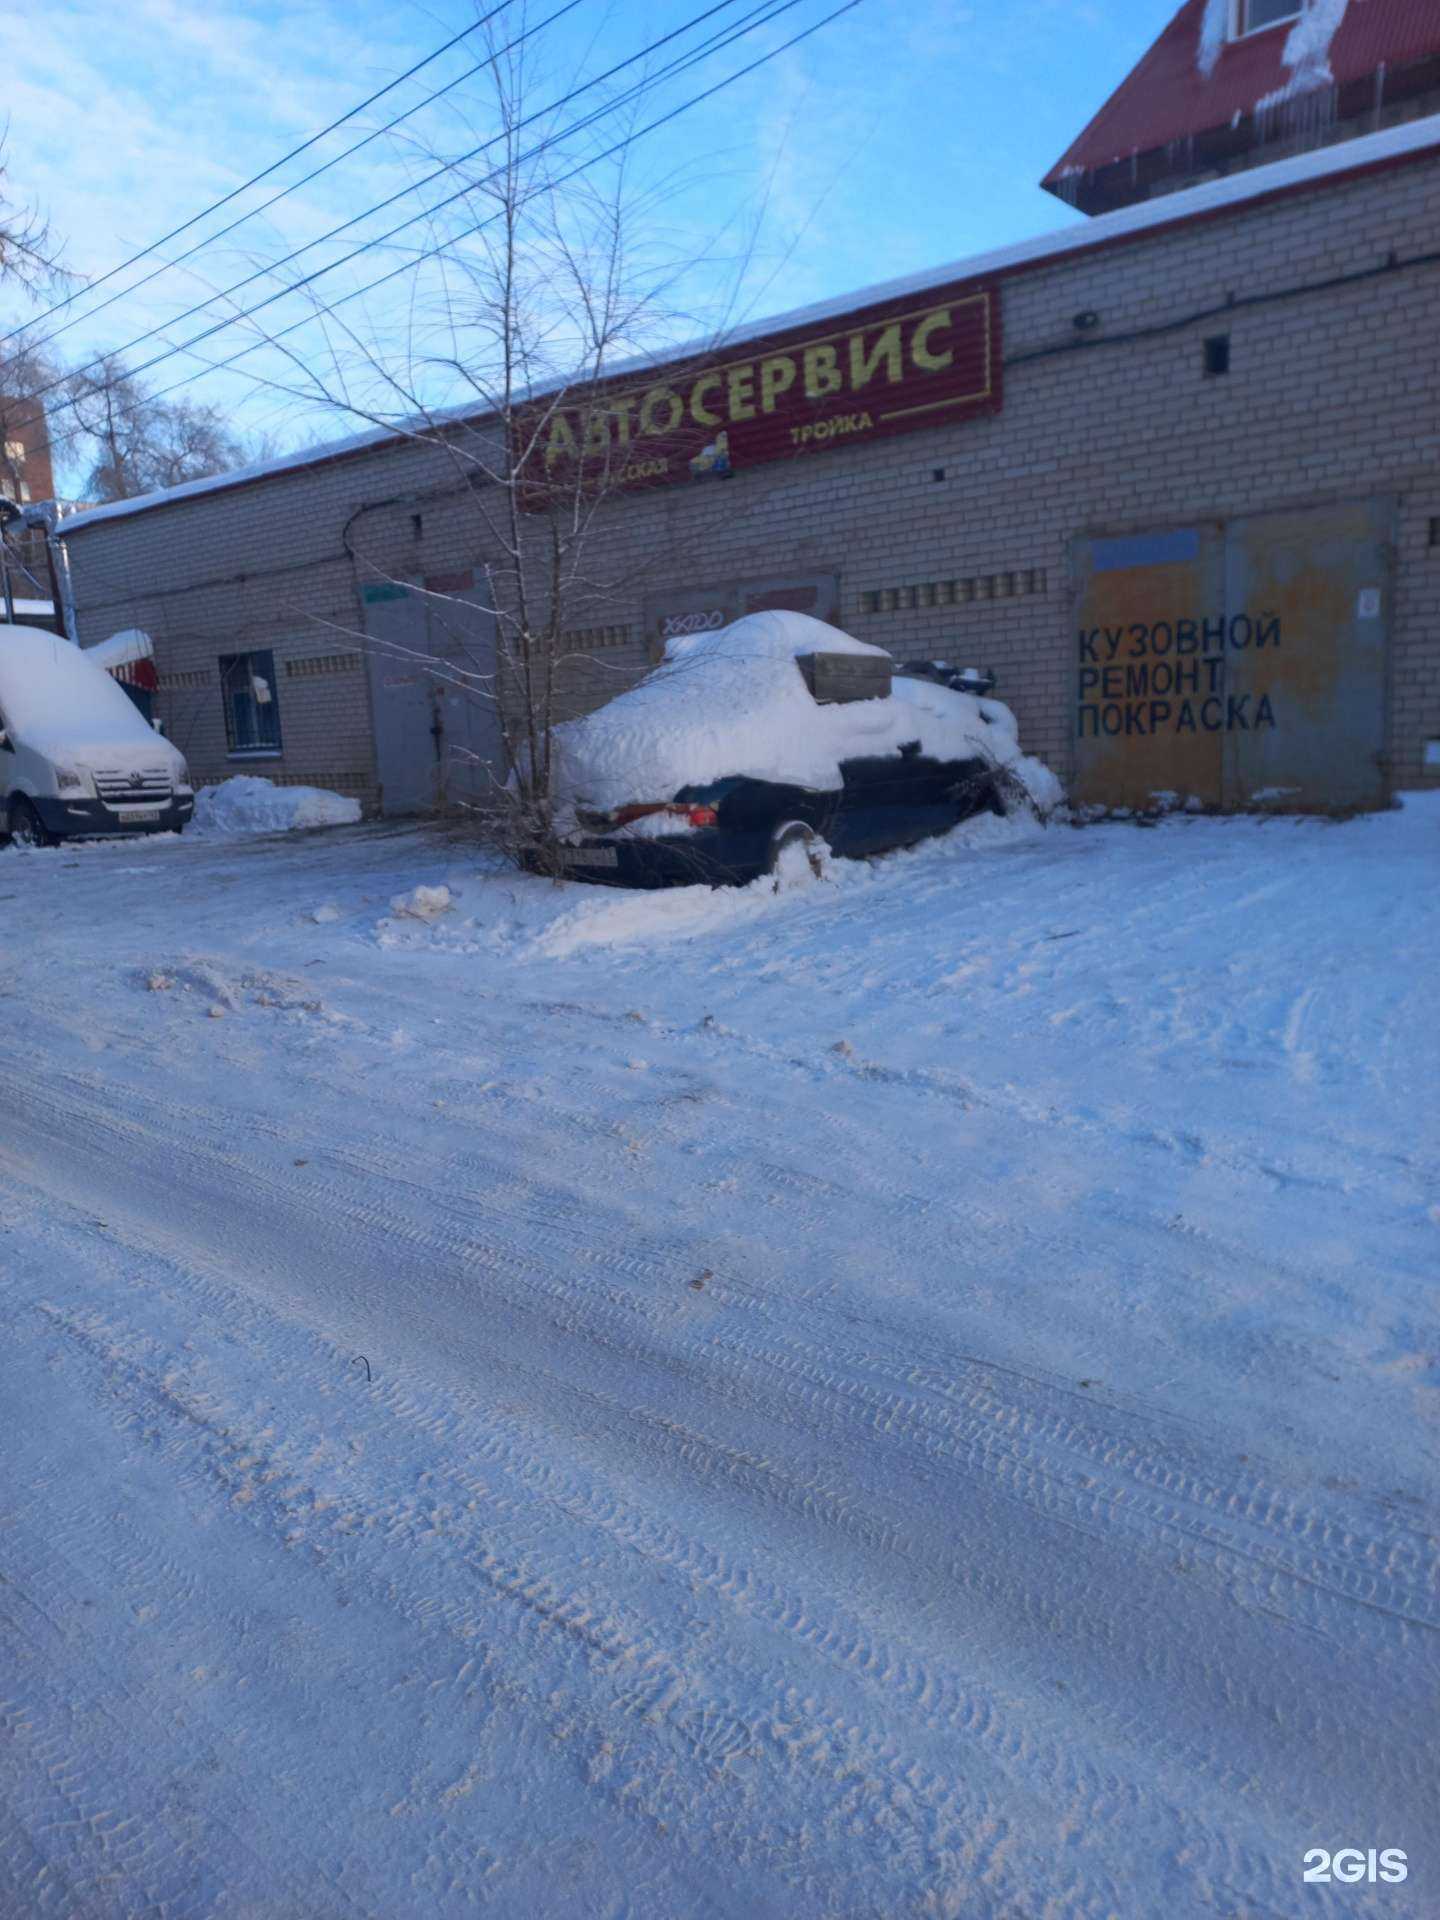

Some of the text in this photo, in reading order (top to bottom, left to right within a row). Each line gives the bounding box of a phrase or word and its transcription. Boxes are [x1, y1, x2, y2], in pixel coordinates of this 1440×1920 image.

[543, 309, 954, 468] АВТОСЕРВИС
[789, 411, 874, 445] ТРОЙКА
[1079, 610, 1281, 662] КУЗОВНОЙ
[1078, 656, 1222, 700] РЕМОНТ
[1076, 693, 1277, 738] ПОКРАСКА
